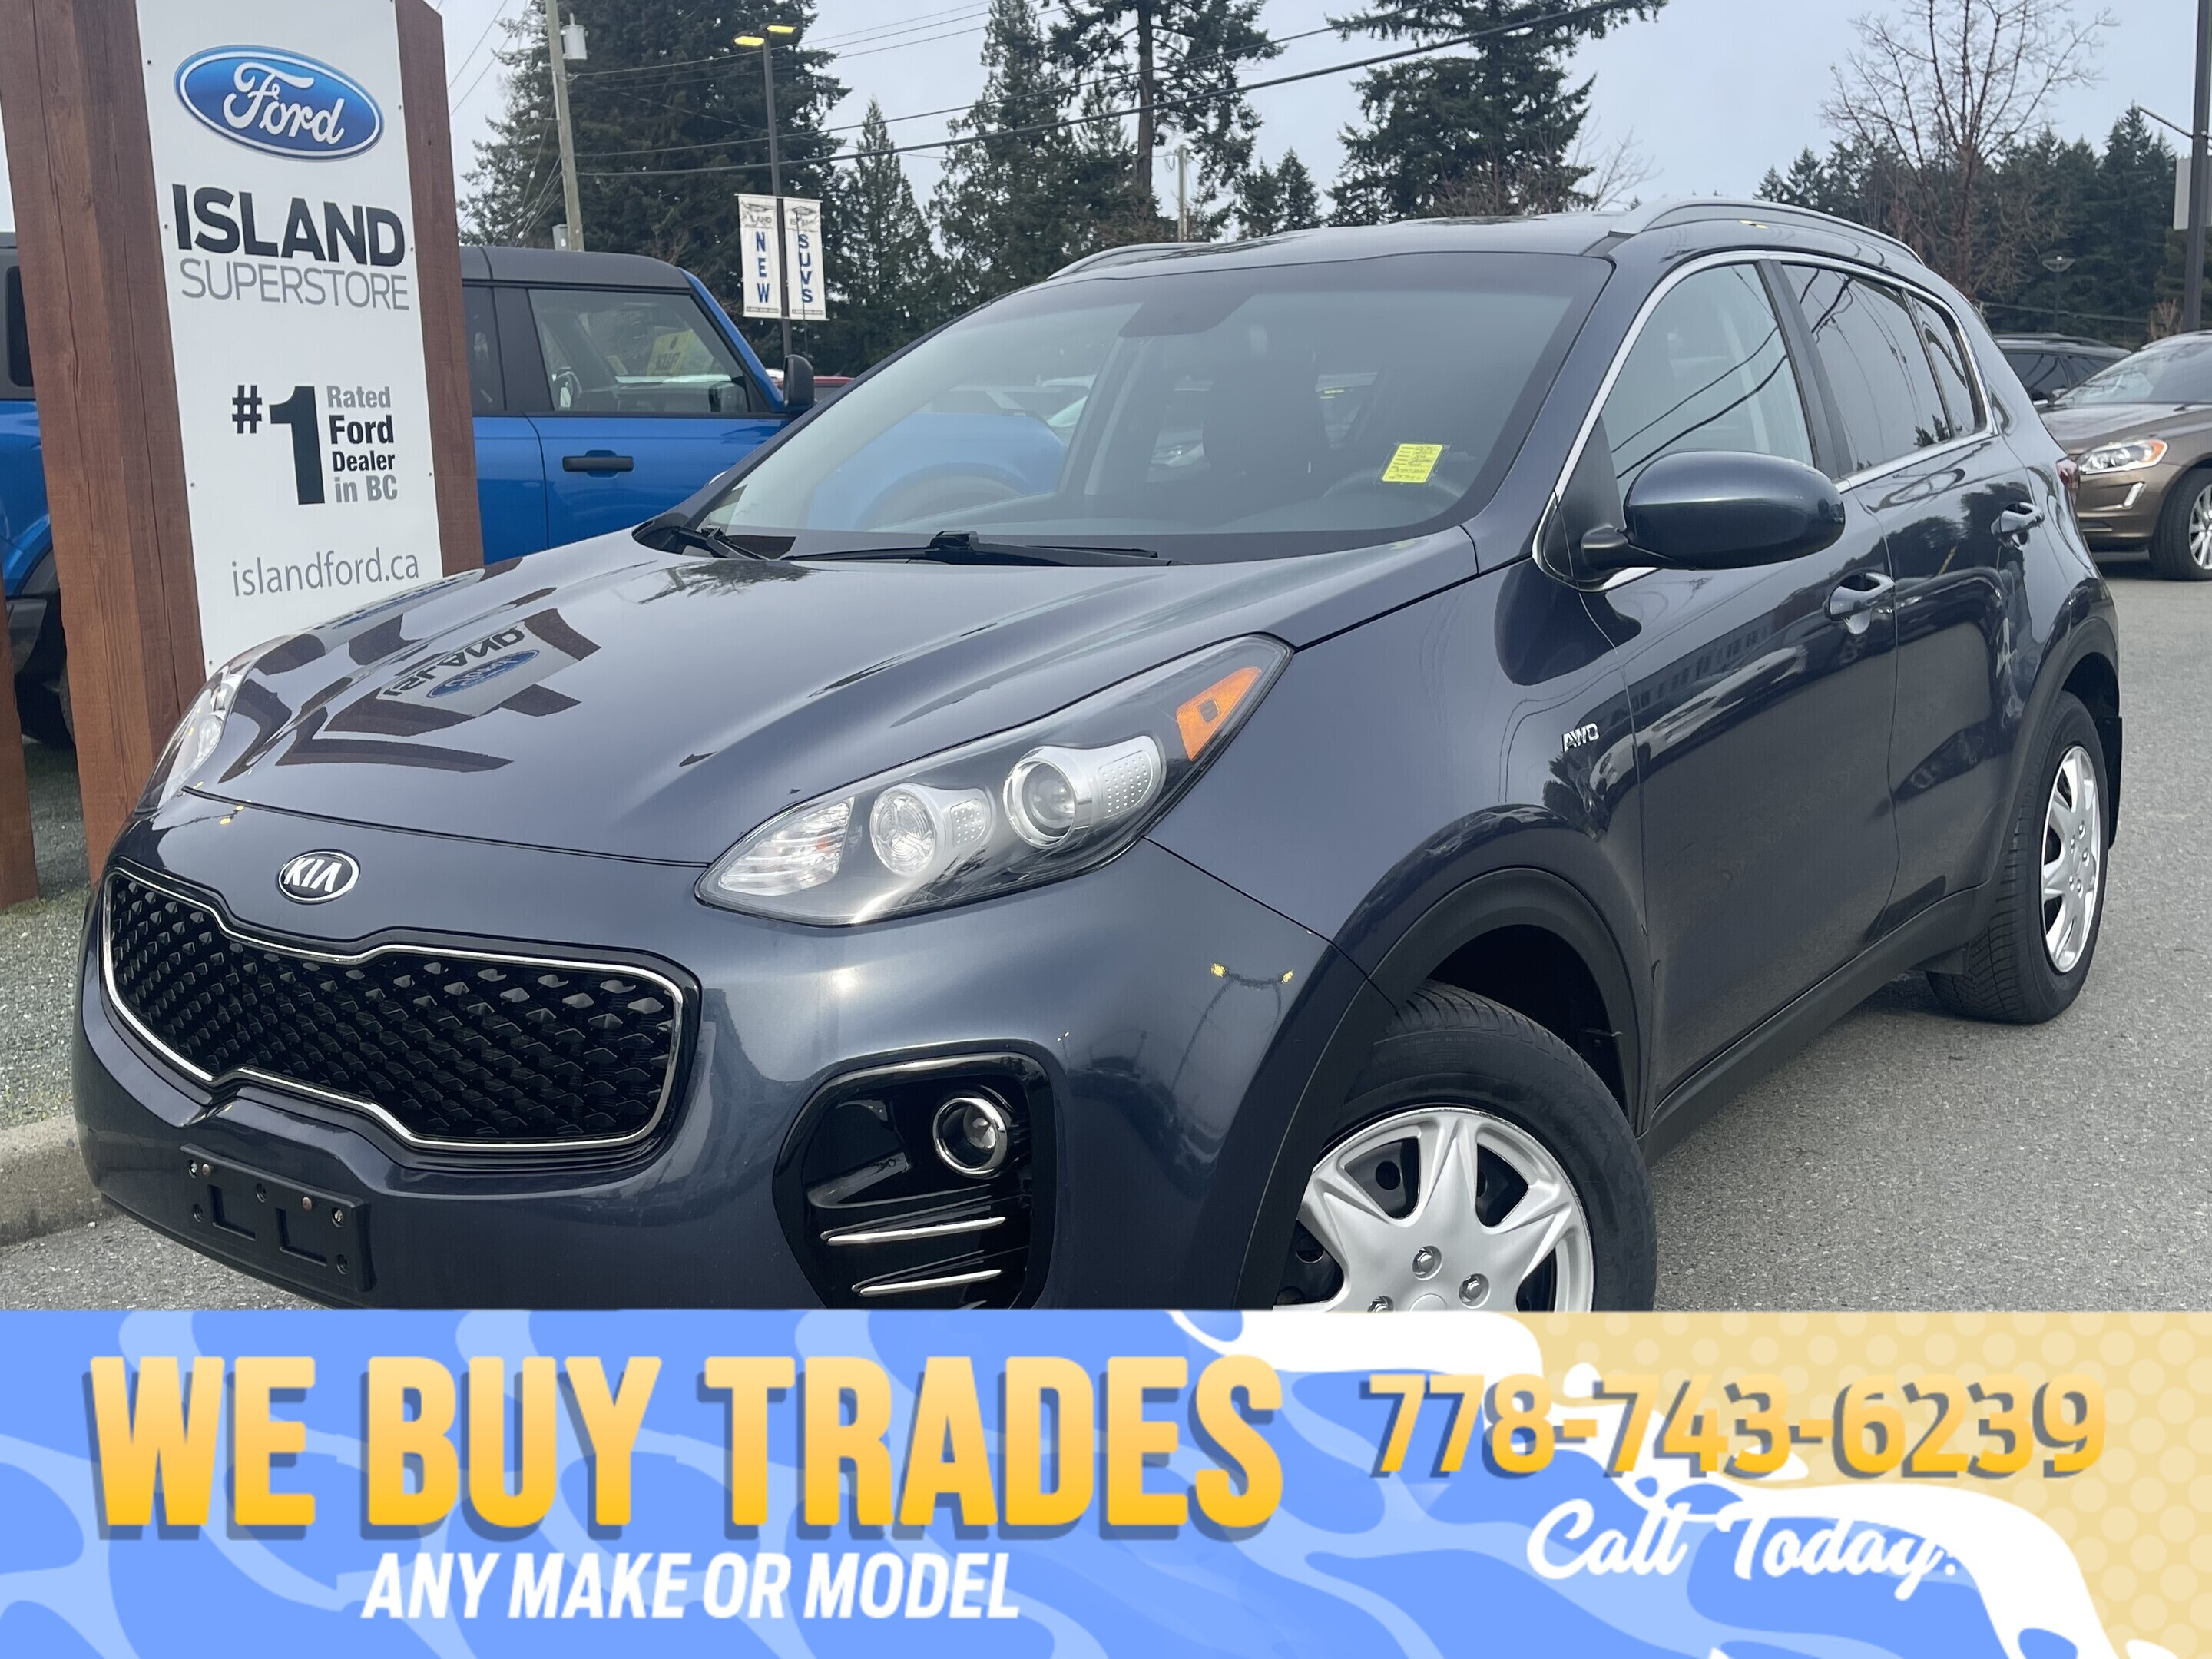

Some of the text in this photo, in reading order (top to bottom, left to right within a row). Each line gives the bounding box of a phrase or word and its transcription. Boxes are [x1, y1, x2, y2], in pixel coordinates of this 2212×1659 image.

[223, 61, 345, 144] Ford
[172, 184, 405, 267] ISLAND
[180, 258, 409, 310] SUPERSTORE
[756, 231, 770, 303] NEW
[798, 233, 813, 303] SUVS
[326, 386, 391, 408] Rated
[329, 414, 394, 445] Ford
[332, 450, 396, 472] Dealer
[334, 474, 398, 503] in BC
[232, 547, 419, 597] islandford.ca
[1561, 722, 1600, 752] AWD
[283, 857, 343, 892] KIA
